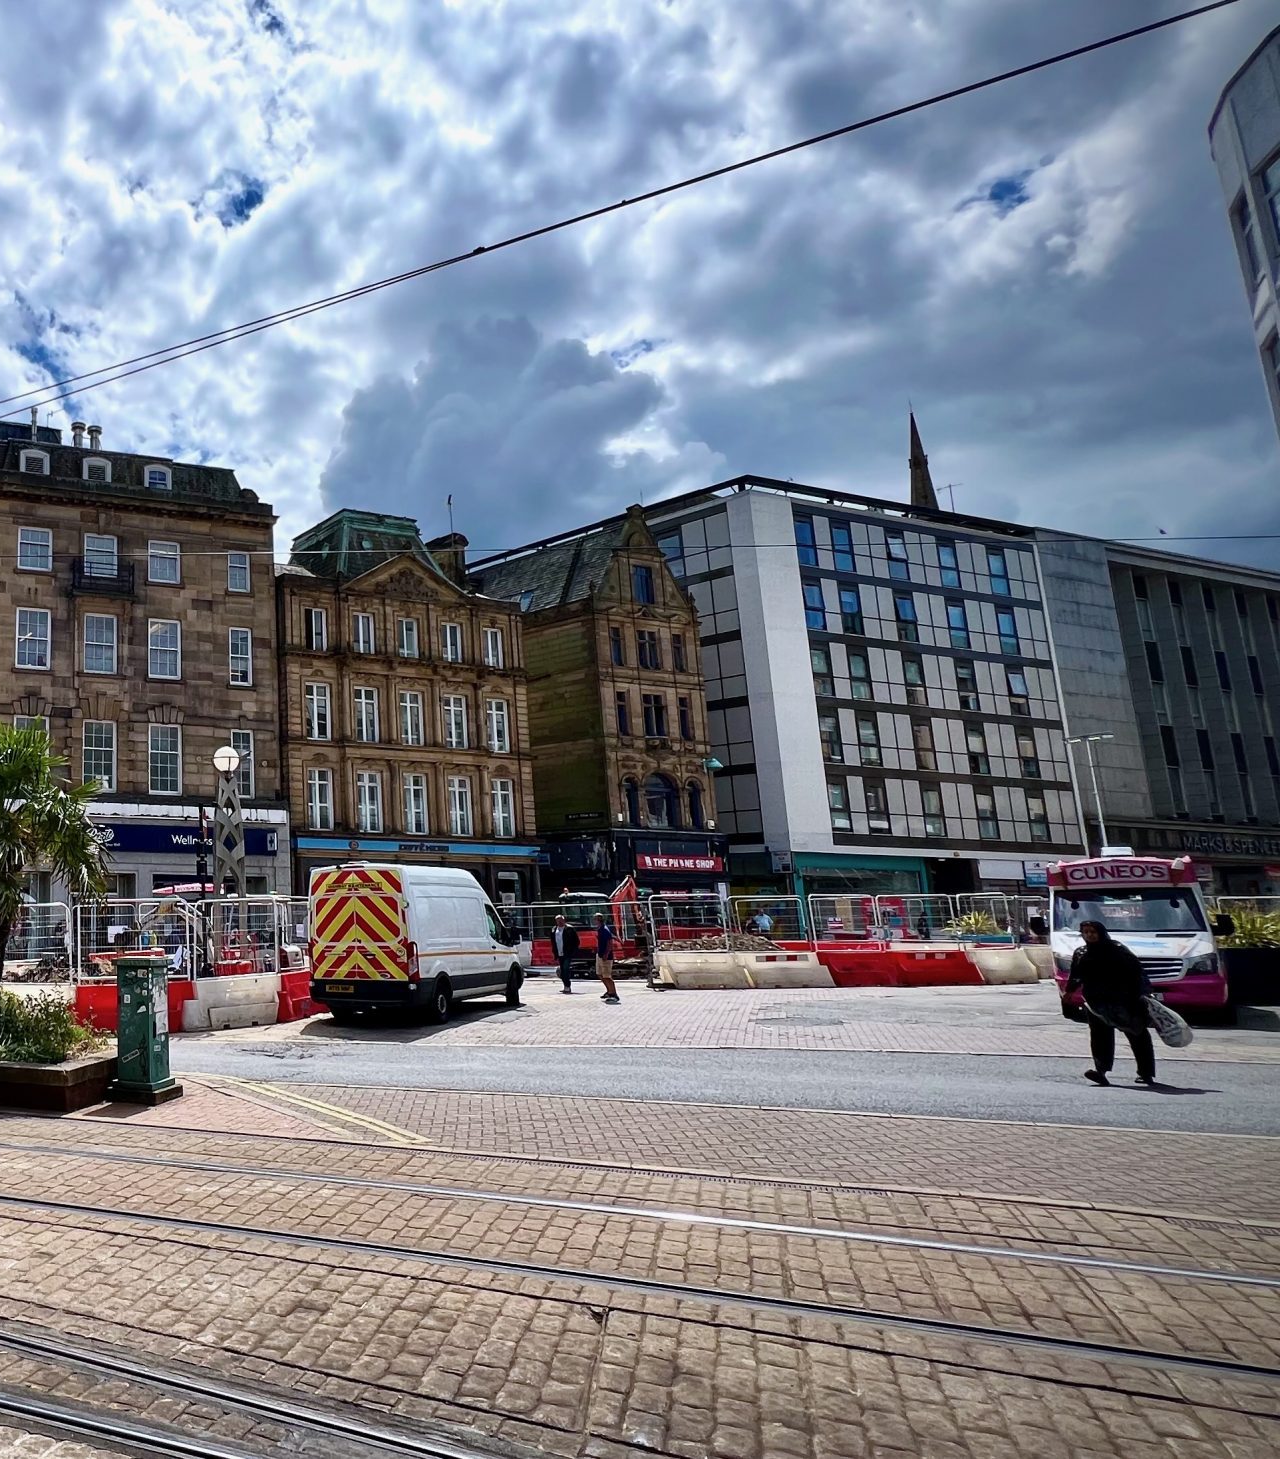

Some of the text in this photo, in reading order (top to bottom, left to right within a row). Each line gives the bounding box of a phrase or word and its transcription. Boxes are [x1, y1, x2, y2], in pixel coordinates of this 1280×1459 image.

[652, 857, 668, 868] THE
[695, 859, 715, 869] SHOP
[1070, 864, 1166, 882] CUNEO'S
